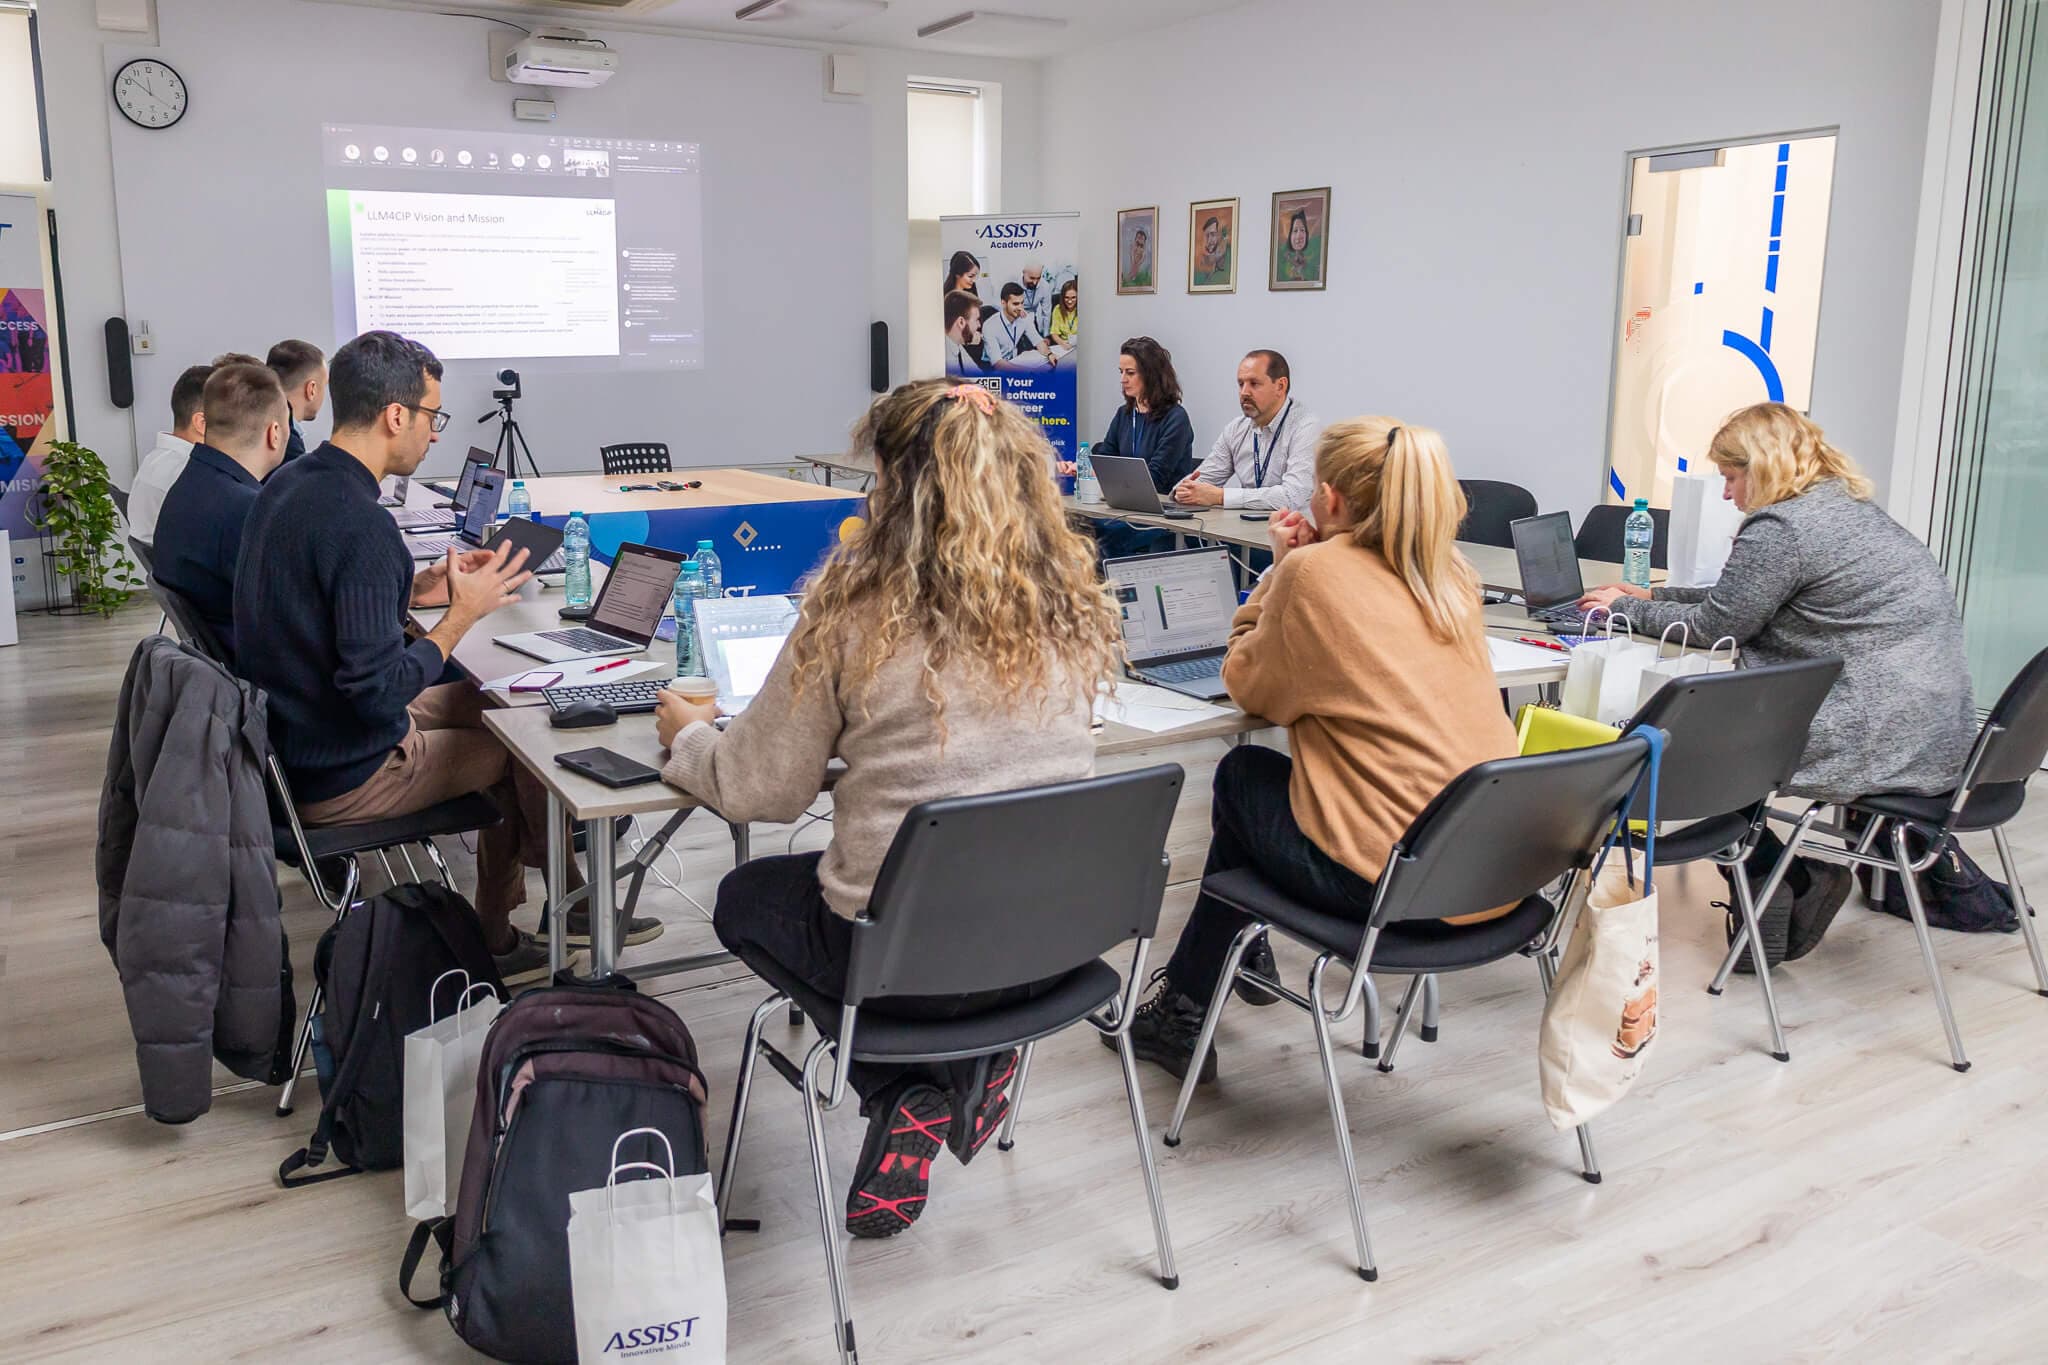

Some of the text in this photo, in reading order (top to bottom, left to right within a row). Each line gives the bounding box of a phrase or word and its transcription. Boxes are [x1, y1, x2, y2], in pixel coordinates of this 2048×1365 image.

[367, 210, 505, 224] LLM4CIP Vision and Mission
[1006, 377, 1034, 388] Your
[1006, 390, 1057, 400] software
[1021, 404, 1044, 413] reer
[1041, 416, 1070, 426] here.
[620, 1340, 691, 1359] Innovative Minds
